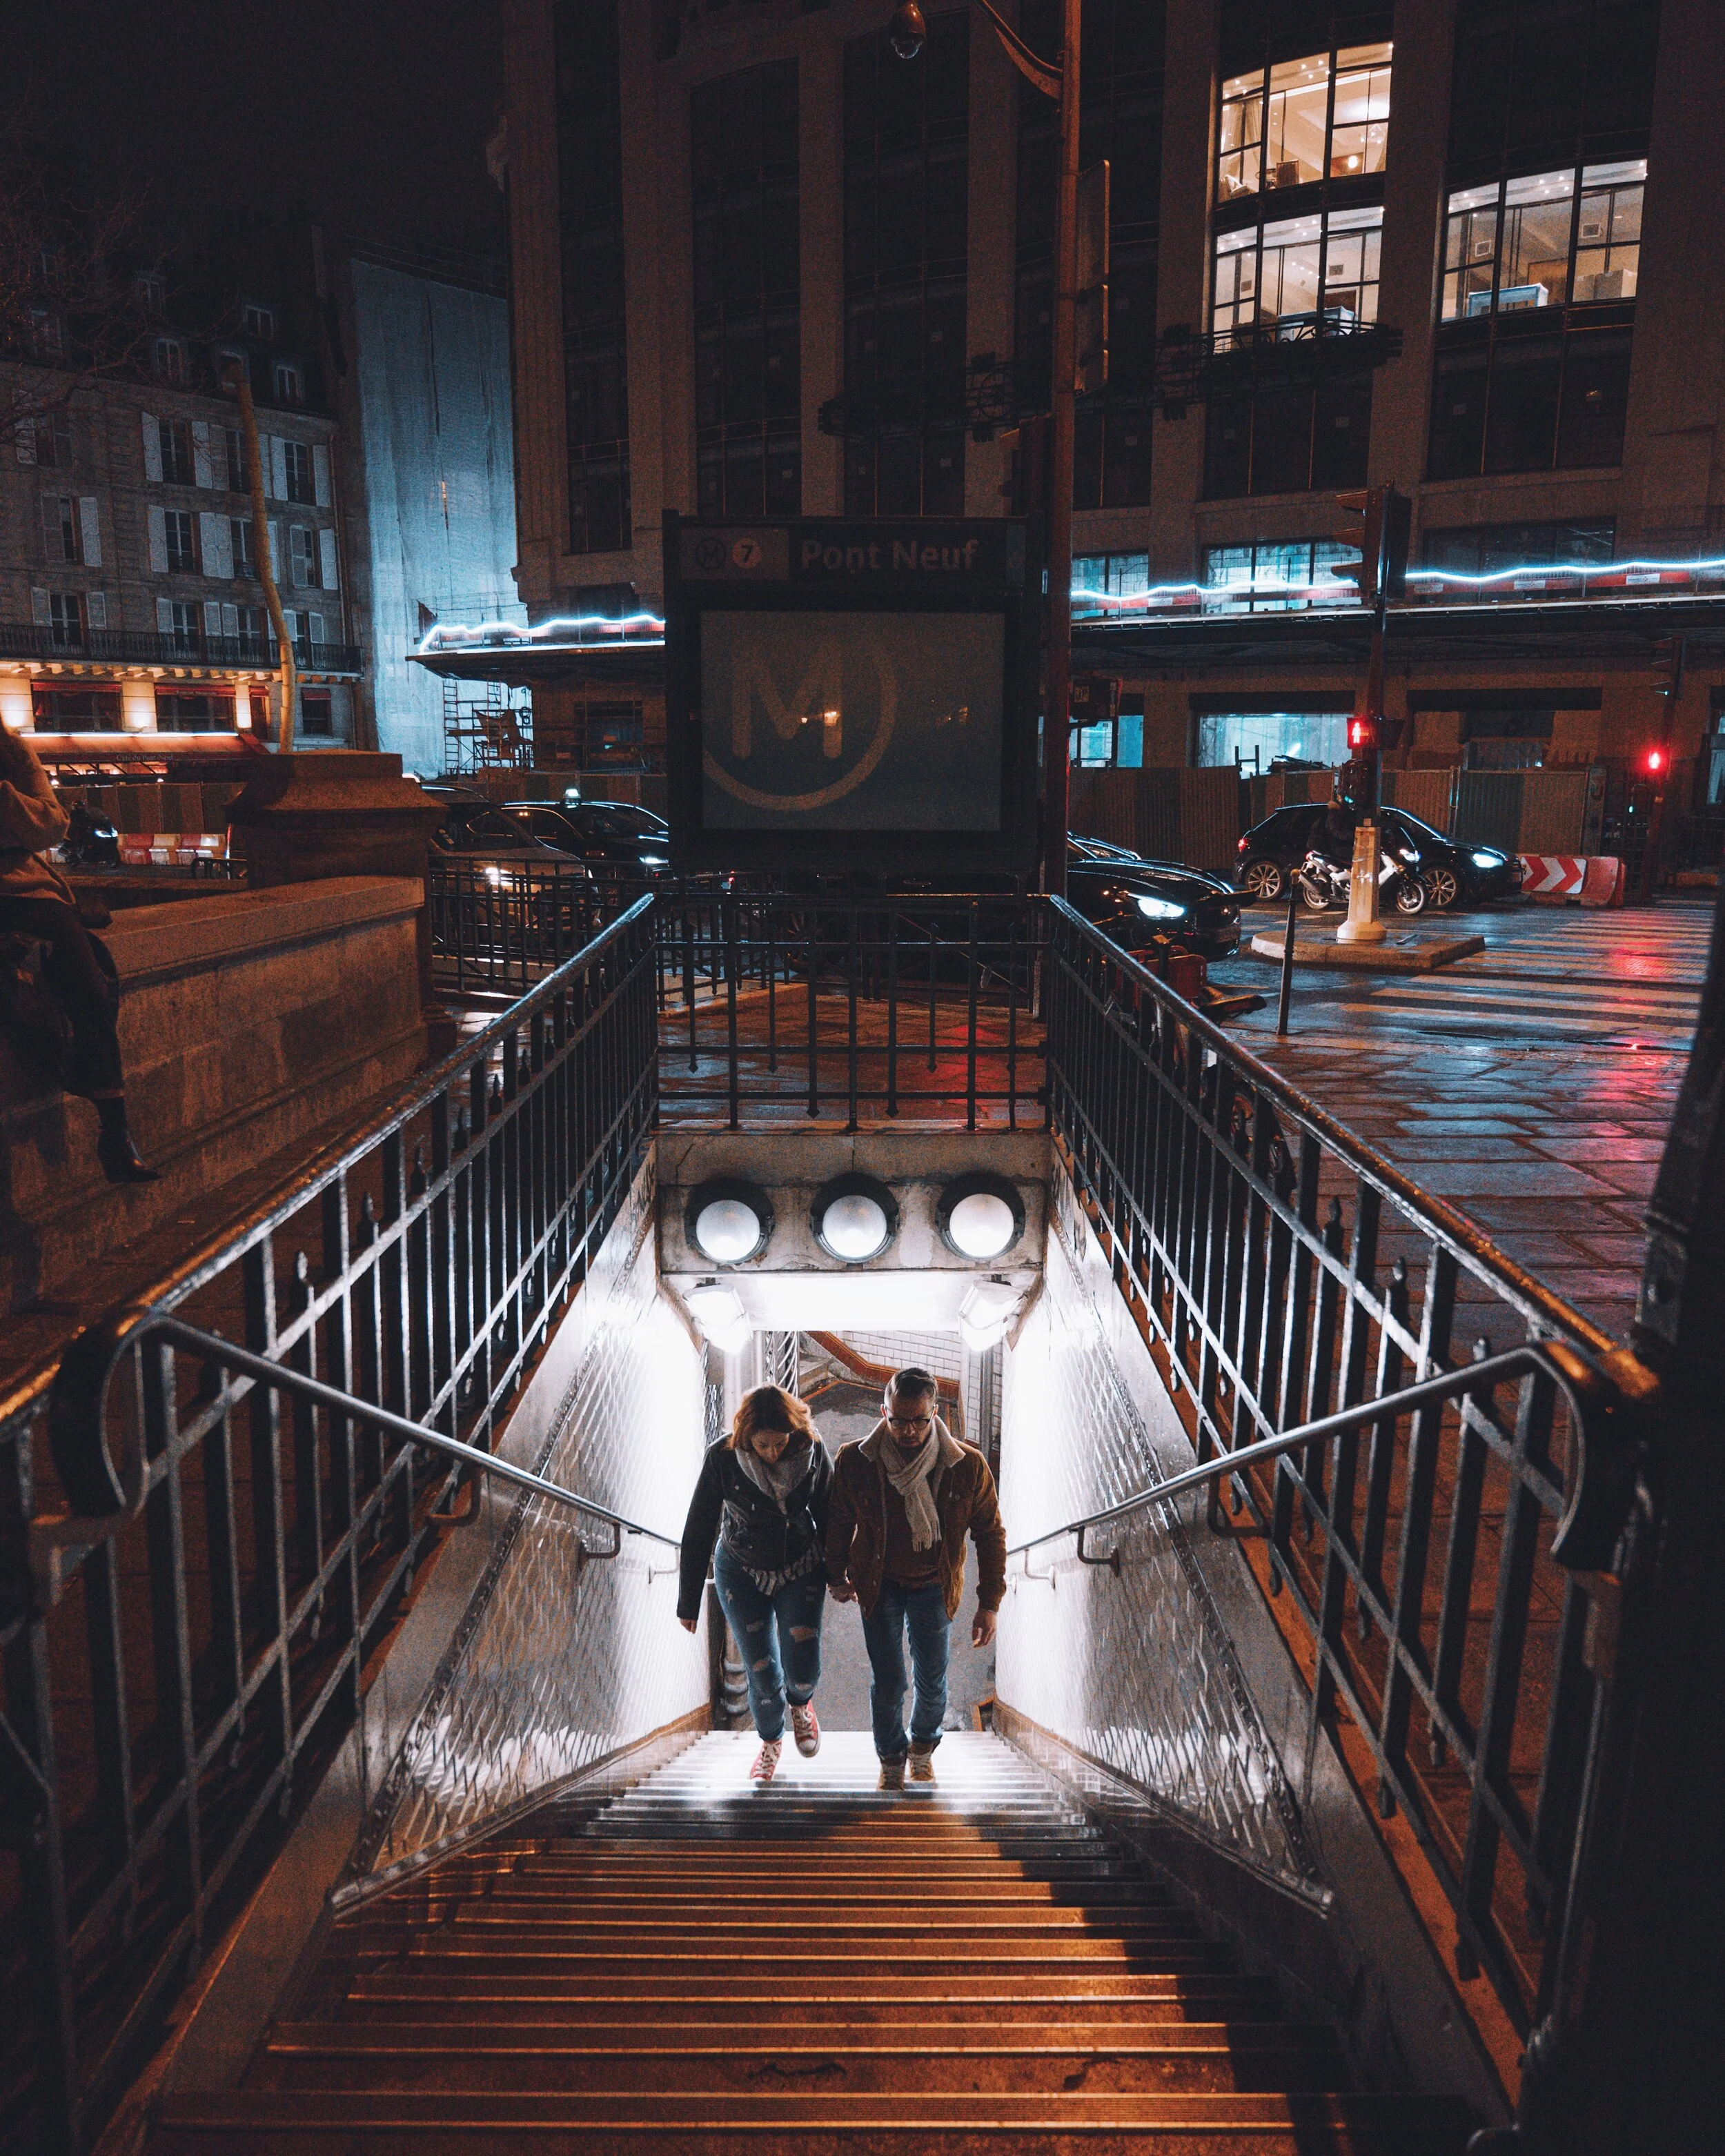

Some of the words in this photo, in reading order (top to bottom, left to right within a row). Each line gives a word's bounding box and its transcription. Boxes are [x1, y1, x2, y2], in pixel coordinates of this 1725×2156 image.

[741, 544, 753, 562] 7
[801, 539, 881, 570] Pont
[892, 537, 979, 571] Neuf
[732, 643, 842, 759] M
